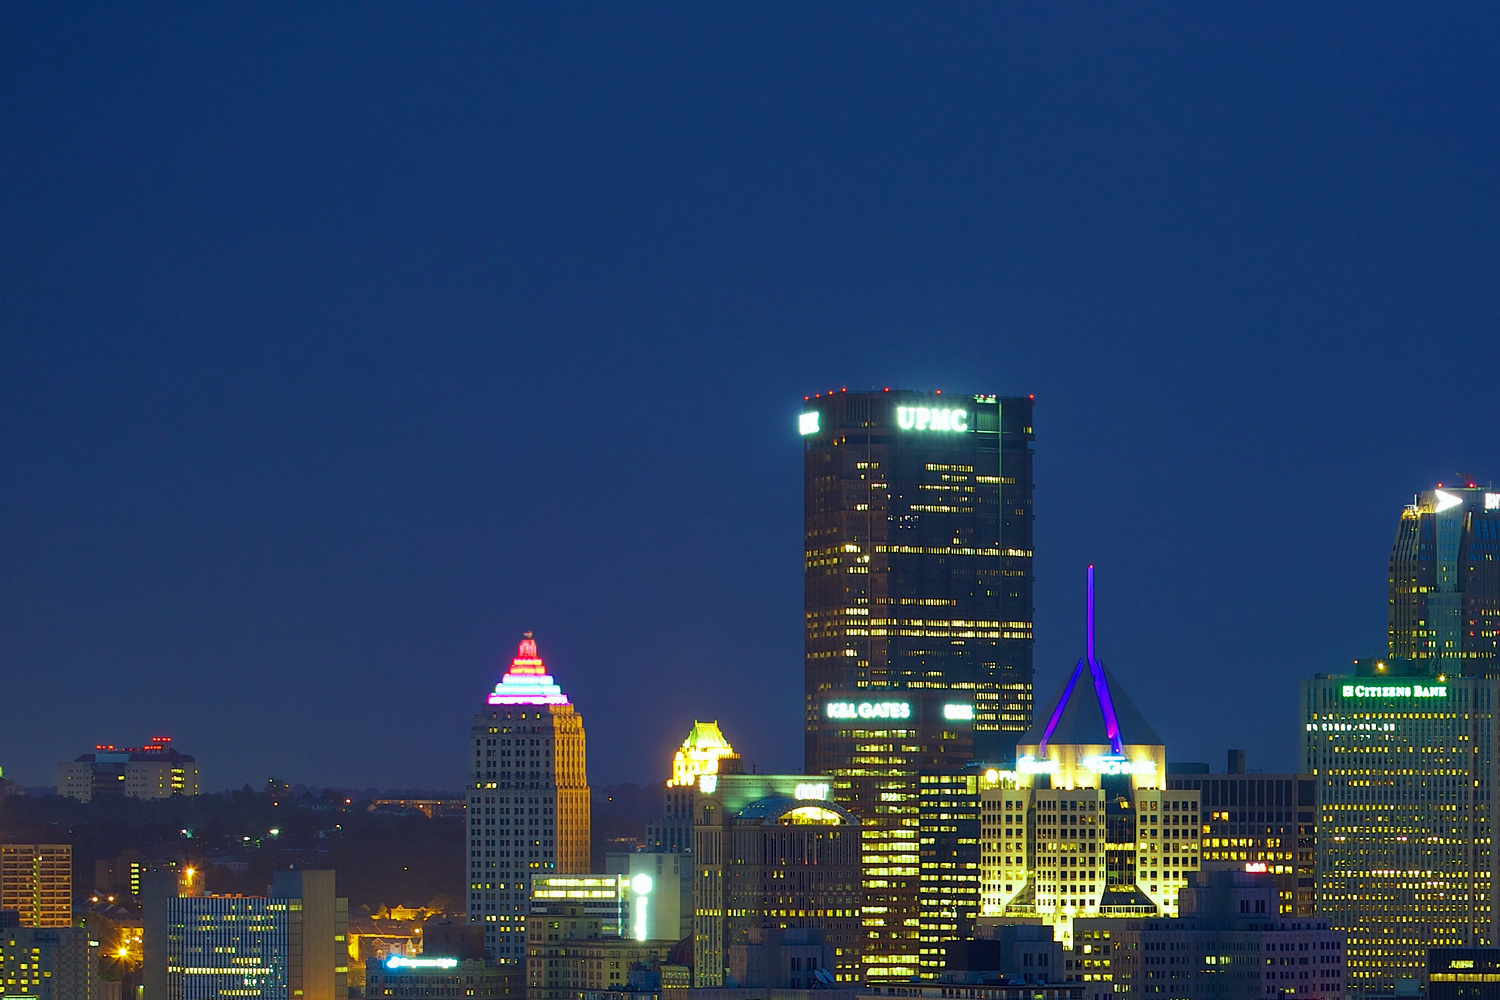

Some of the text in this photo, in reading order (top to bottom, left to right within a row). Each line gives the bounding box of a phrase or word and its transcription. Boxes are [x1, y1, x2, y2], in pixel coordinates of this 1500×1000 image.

[896, 406, 968, 432] UPMC
[1413, 685, 1447, 697] BANK
[827, 702, 910, 719] K&L GATES
